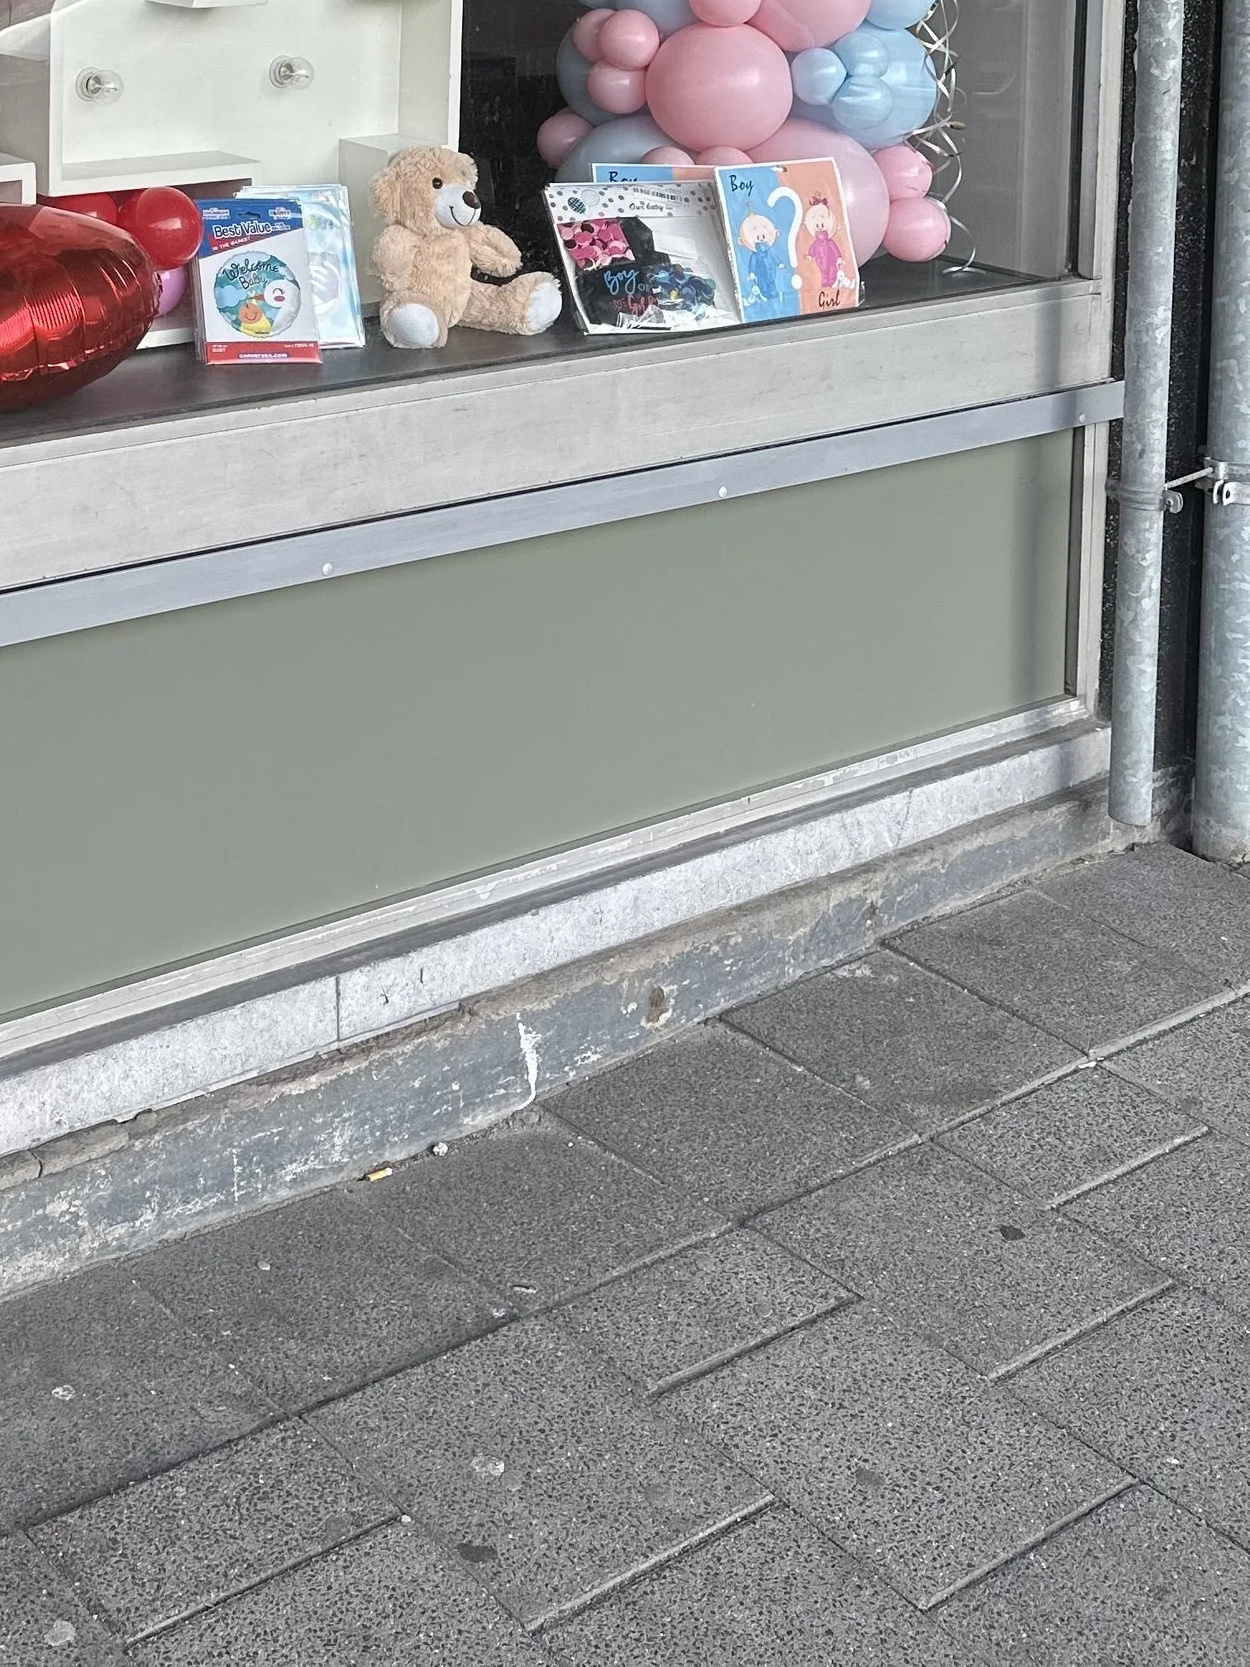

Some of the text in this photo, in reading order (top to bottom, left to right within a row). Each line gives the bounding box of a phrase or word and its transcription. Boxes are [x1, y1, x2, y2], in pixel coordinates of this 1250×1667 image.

[729, 173, 754, 196] Boy
[214, 223, 241, 238] Best
[242, 220, 271, 236] Value
[222, 258, 280, 290] Welcome Baby
[604, 269, 639, 295] Boy
[818, 291, 841, 308] Girl
